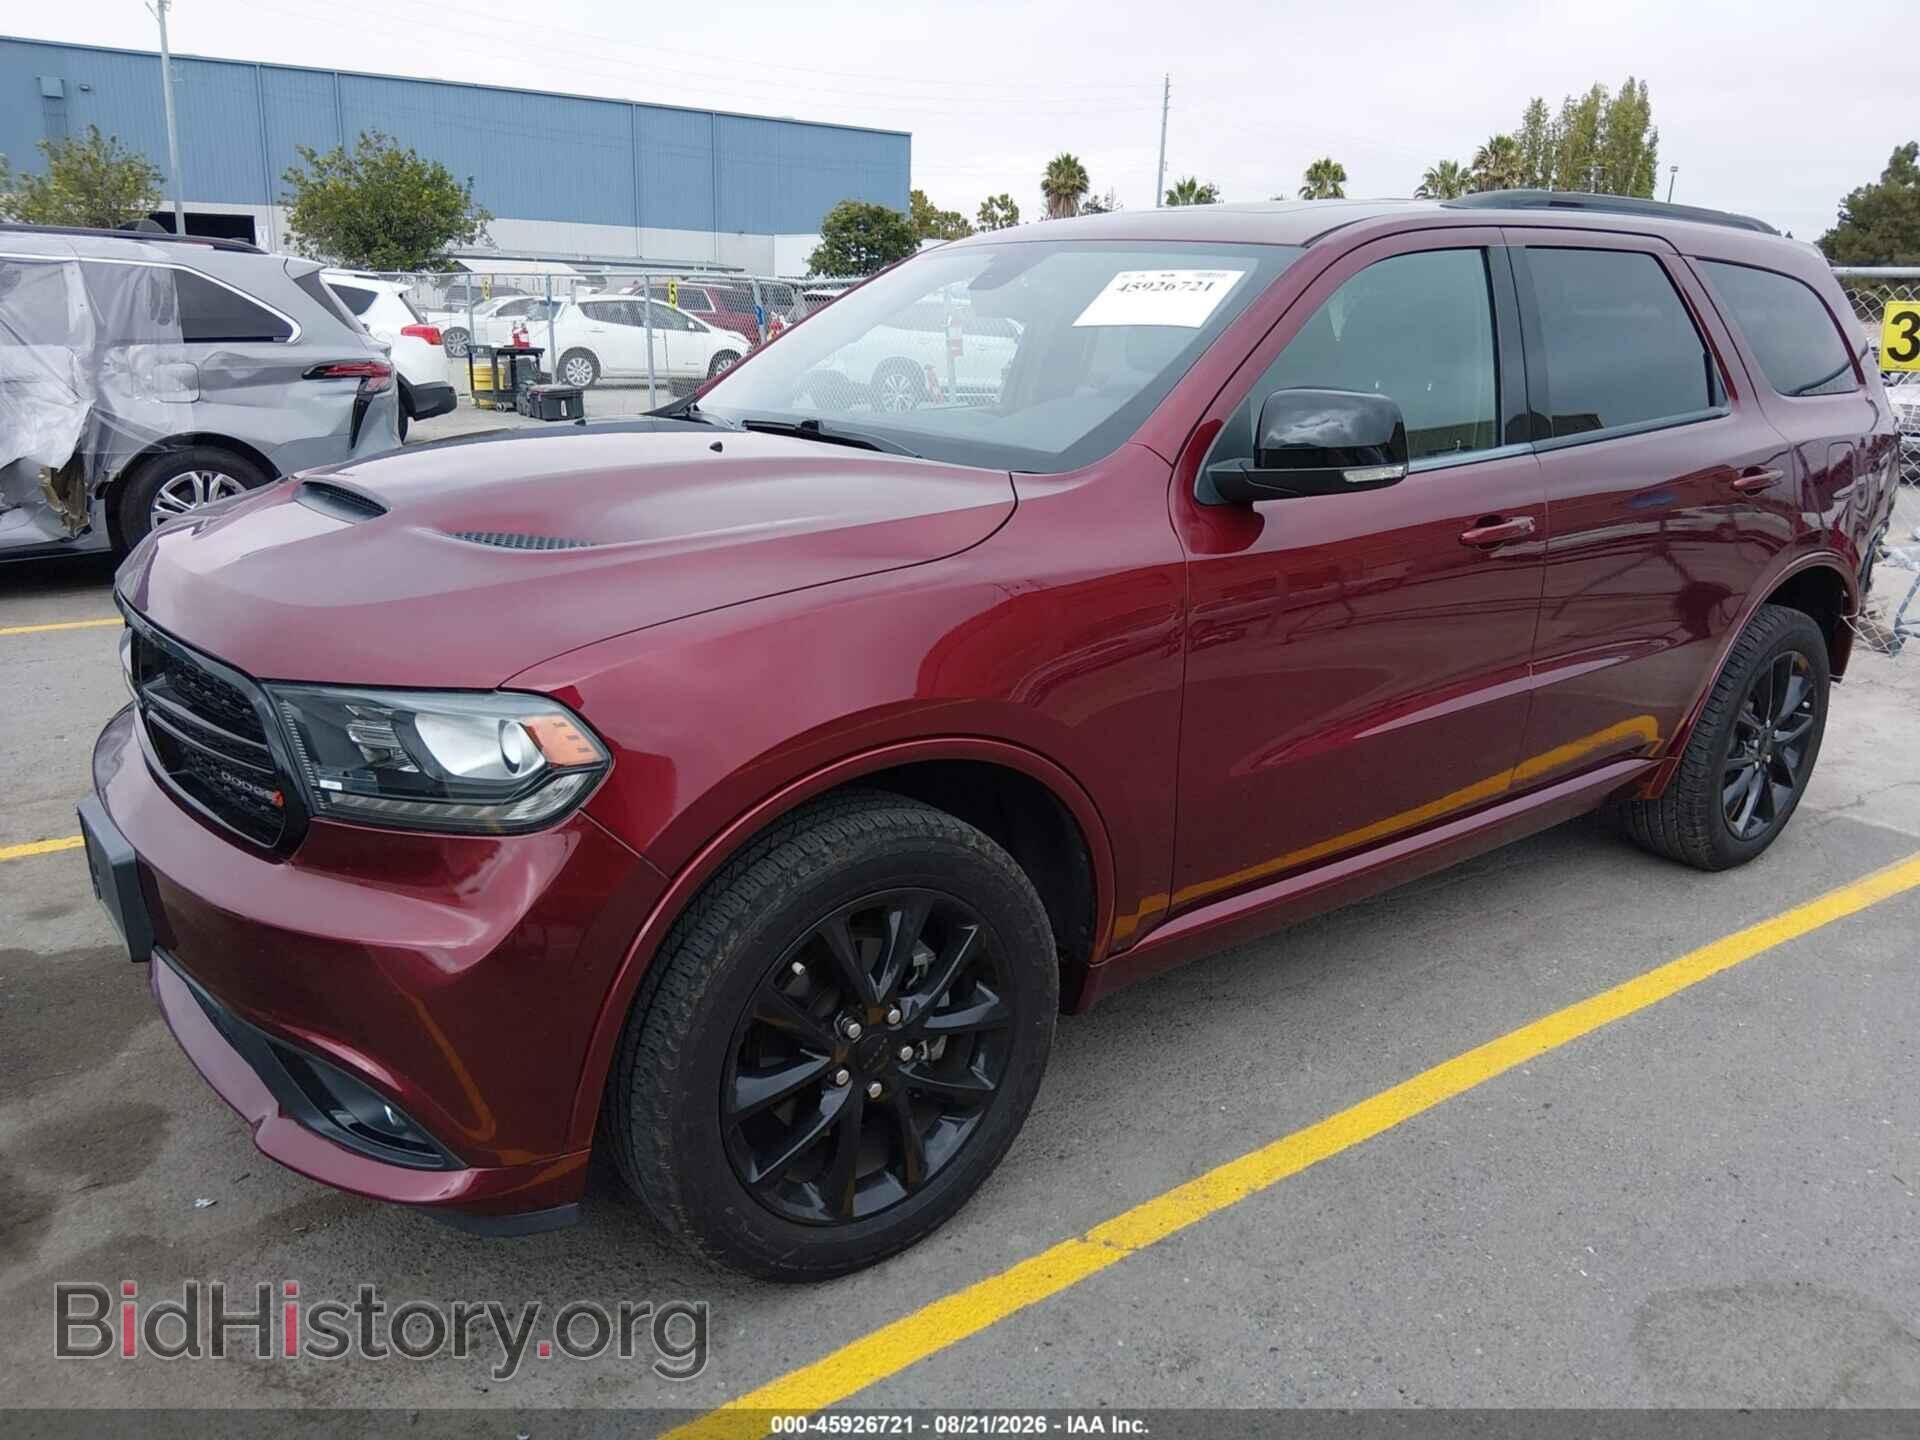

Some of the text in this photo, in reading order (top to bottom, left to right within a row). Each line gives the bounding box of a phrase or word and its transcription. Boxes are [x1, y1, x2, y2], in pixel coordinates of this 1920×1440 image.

[670, 283, 677, 305] 5
[1116, 280, 1216, 293] 45926721
[1887, 311, 1920, 363] 3
[221, 770, 273, 800] DODGE
